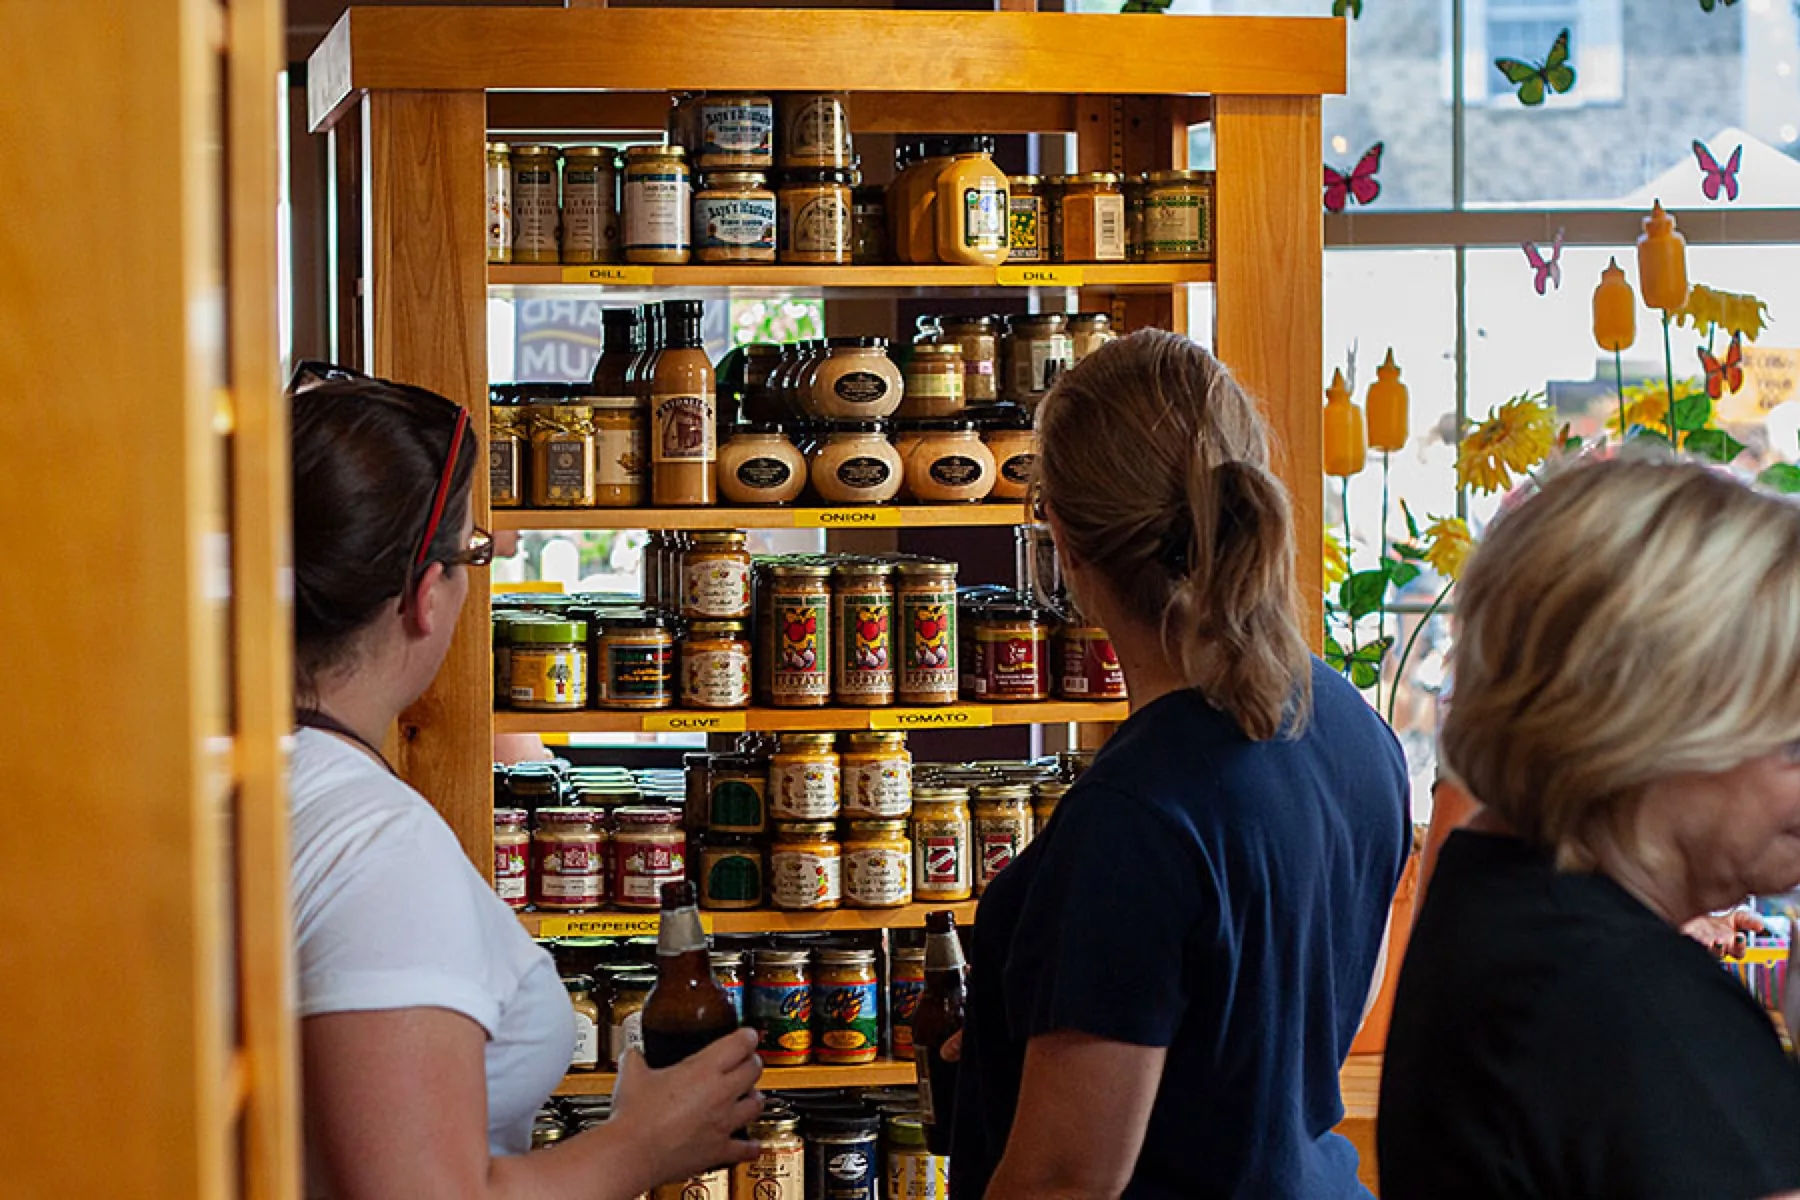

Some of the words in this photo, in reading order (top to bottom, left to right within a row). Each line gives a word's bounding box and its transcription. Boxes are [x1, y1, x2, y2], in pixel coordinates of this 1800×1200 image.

[589, 270, 626, 279] DILL
[1022, 271, 1059, 281] DILL
[819, 512, 877, 523] ONION
[669, 717, 721, 728] OLIVE
[896, 712, 970, 724] TOMATO
[567, 921, 660, 932] PEPPERCO
